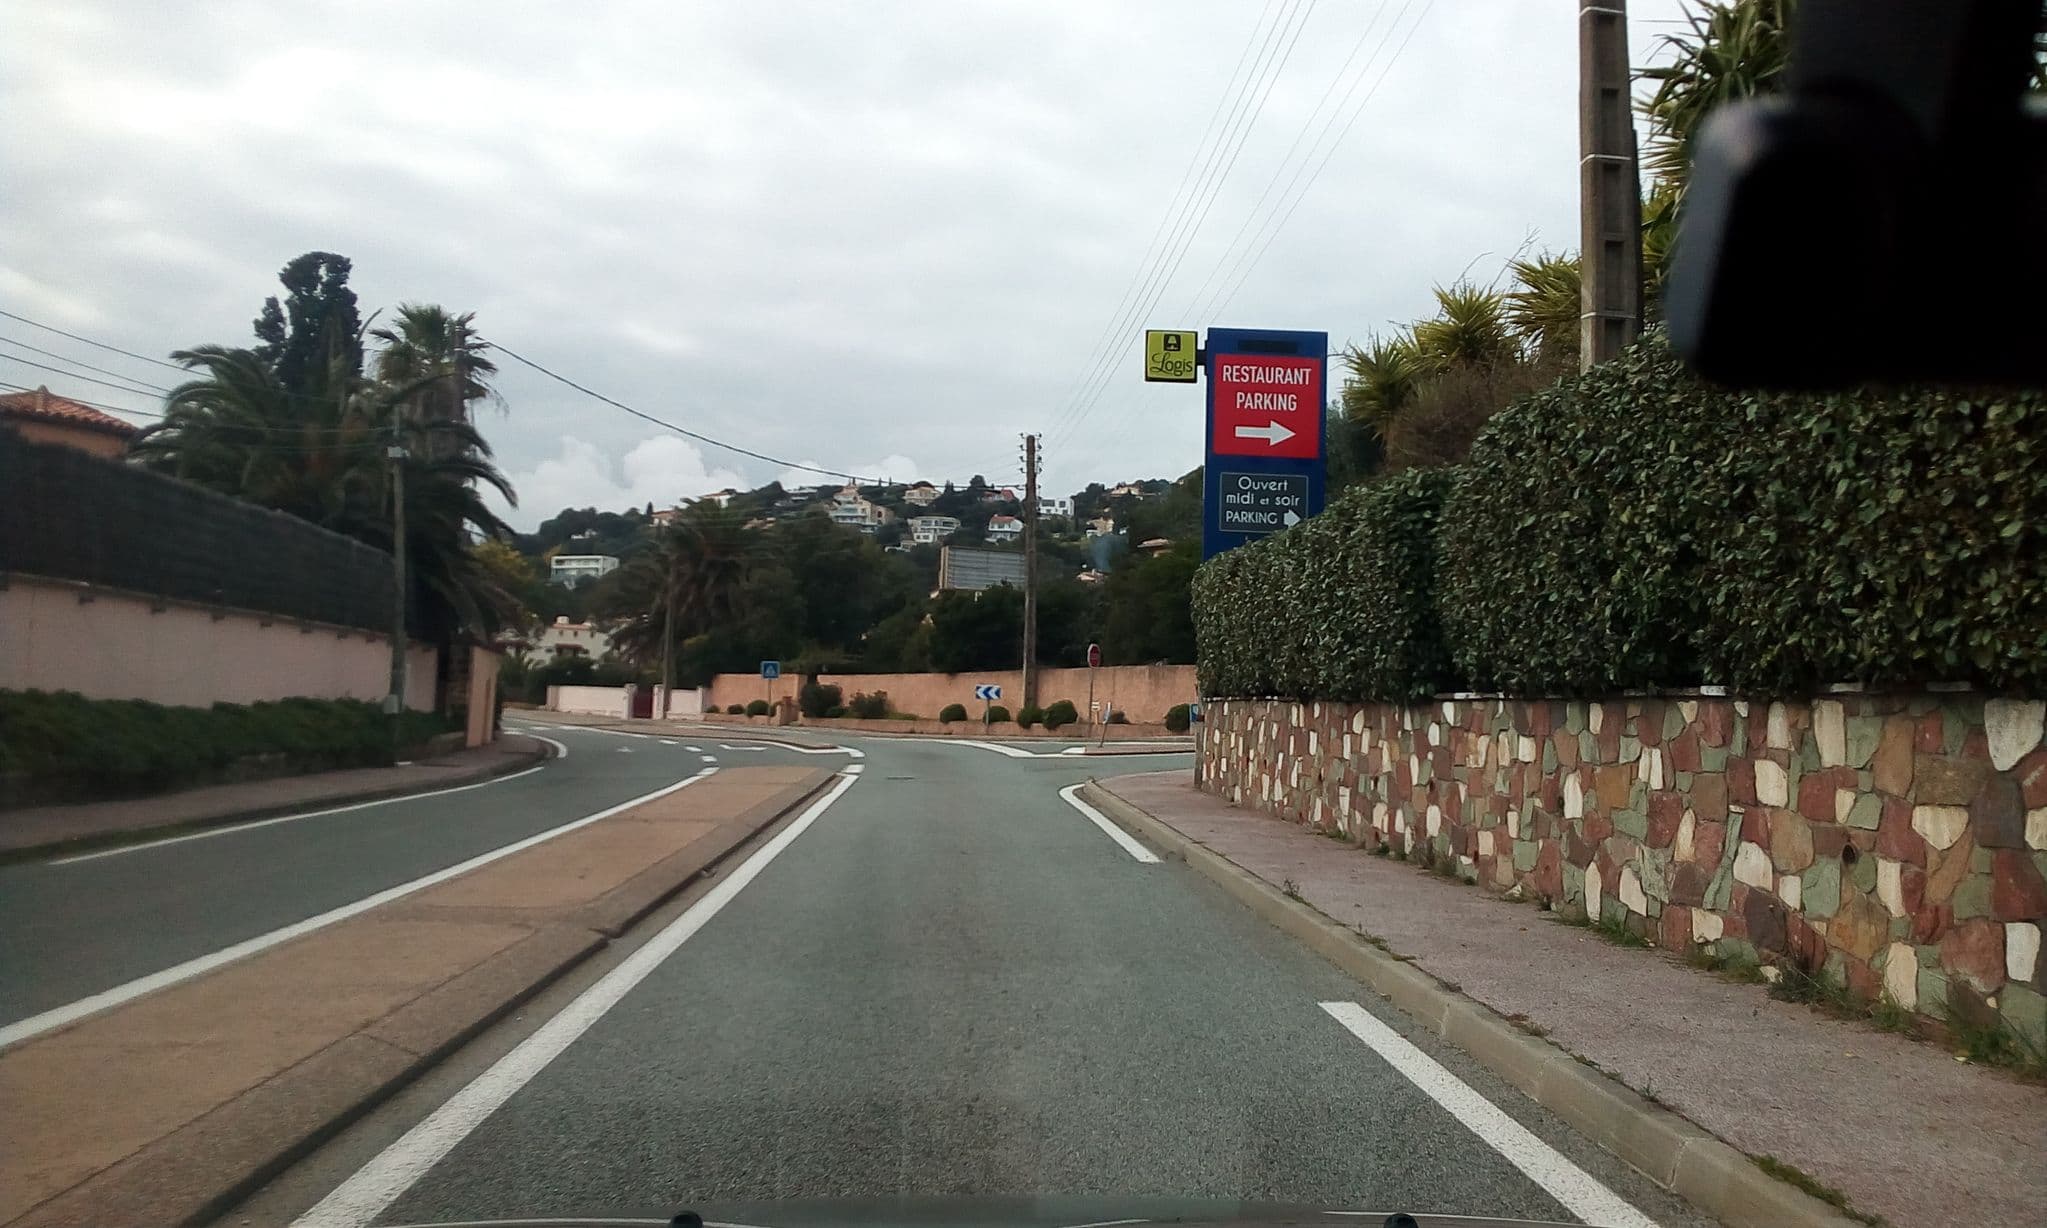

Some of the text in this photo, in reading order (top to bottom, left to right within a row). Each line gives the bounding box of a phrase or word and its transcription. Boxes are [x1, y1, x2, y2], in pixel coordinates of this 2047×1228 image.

[1151, 352, 1193, 377] Logis
[1222, 365, 1312, 385] RESTAURANT
[1236, 391, 1297, 411] PARKING
[1238, 476, 1289, 492] Ouvert
[1226, 492, 1300, 507] midi et soir
[1225, 511, 1278, 525] PARKING
